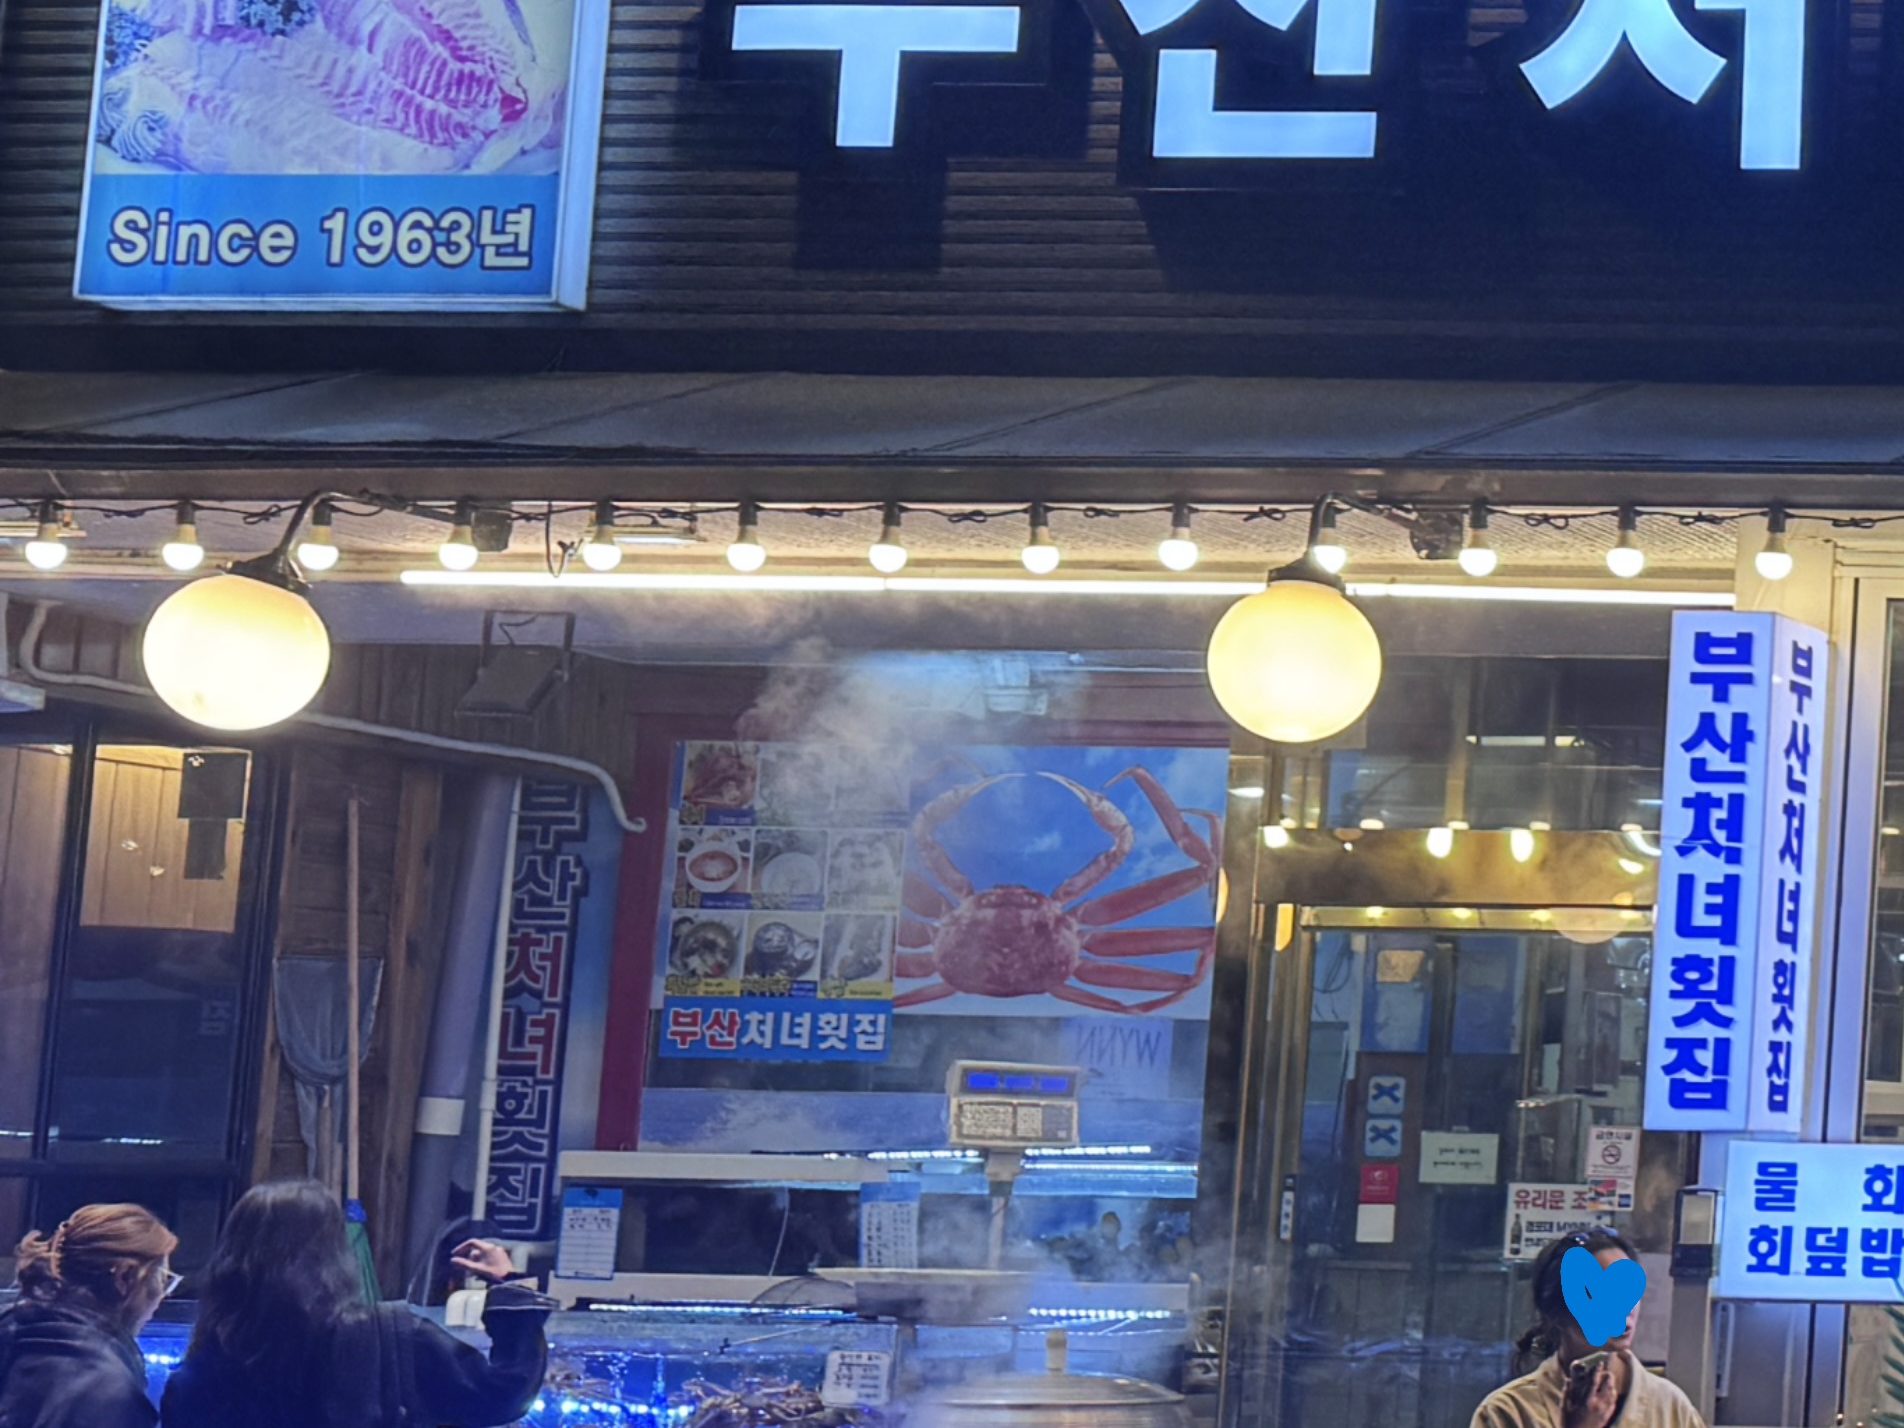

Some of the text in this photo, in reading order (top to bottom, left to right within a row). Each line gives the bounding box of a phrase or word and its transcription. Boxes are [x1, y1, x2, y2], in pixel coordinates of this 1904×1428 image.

[108, 205, 535, 270] Since 1963년
[1661, 631, 1755, 1111] 부산처녀횟집
[1766, 640, 1813, 1113] 부산처녀횟집
[668, 1007, 886, 1051] 부산처녀횟집
[1514, 1189, 1565, 1210] 유리문
